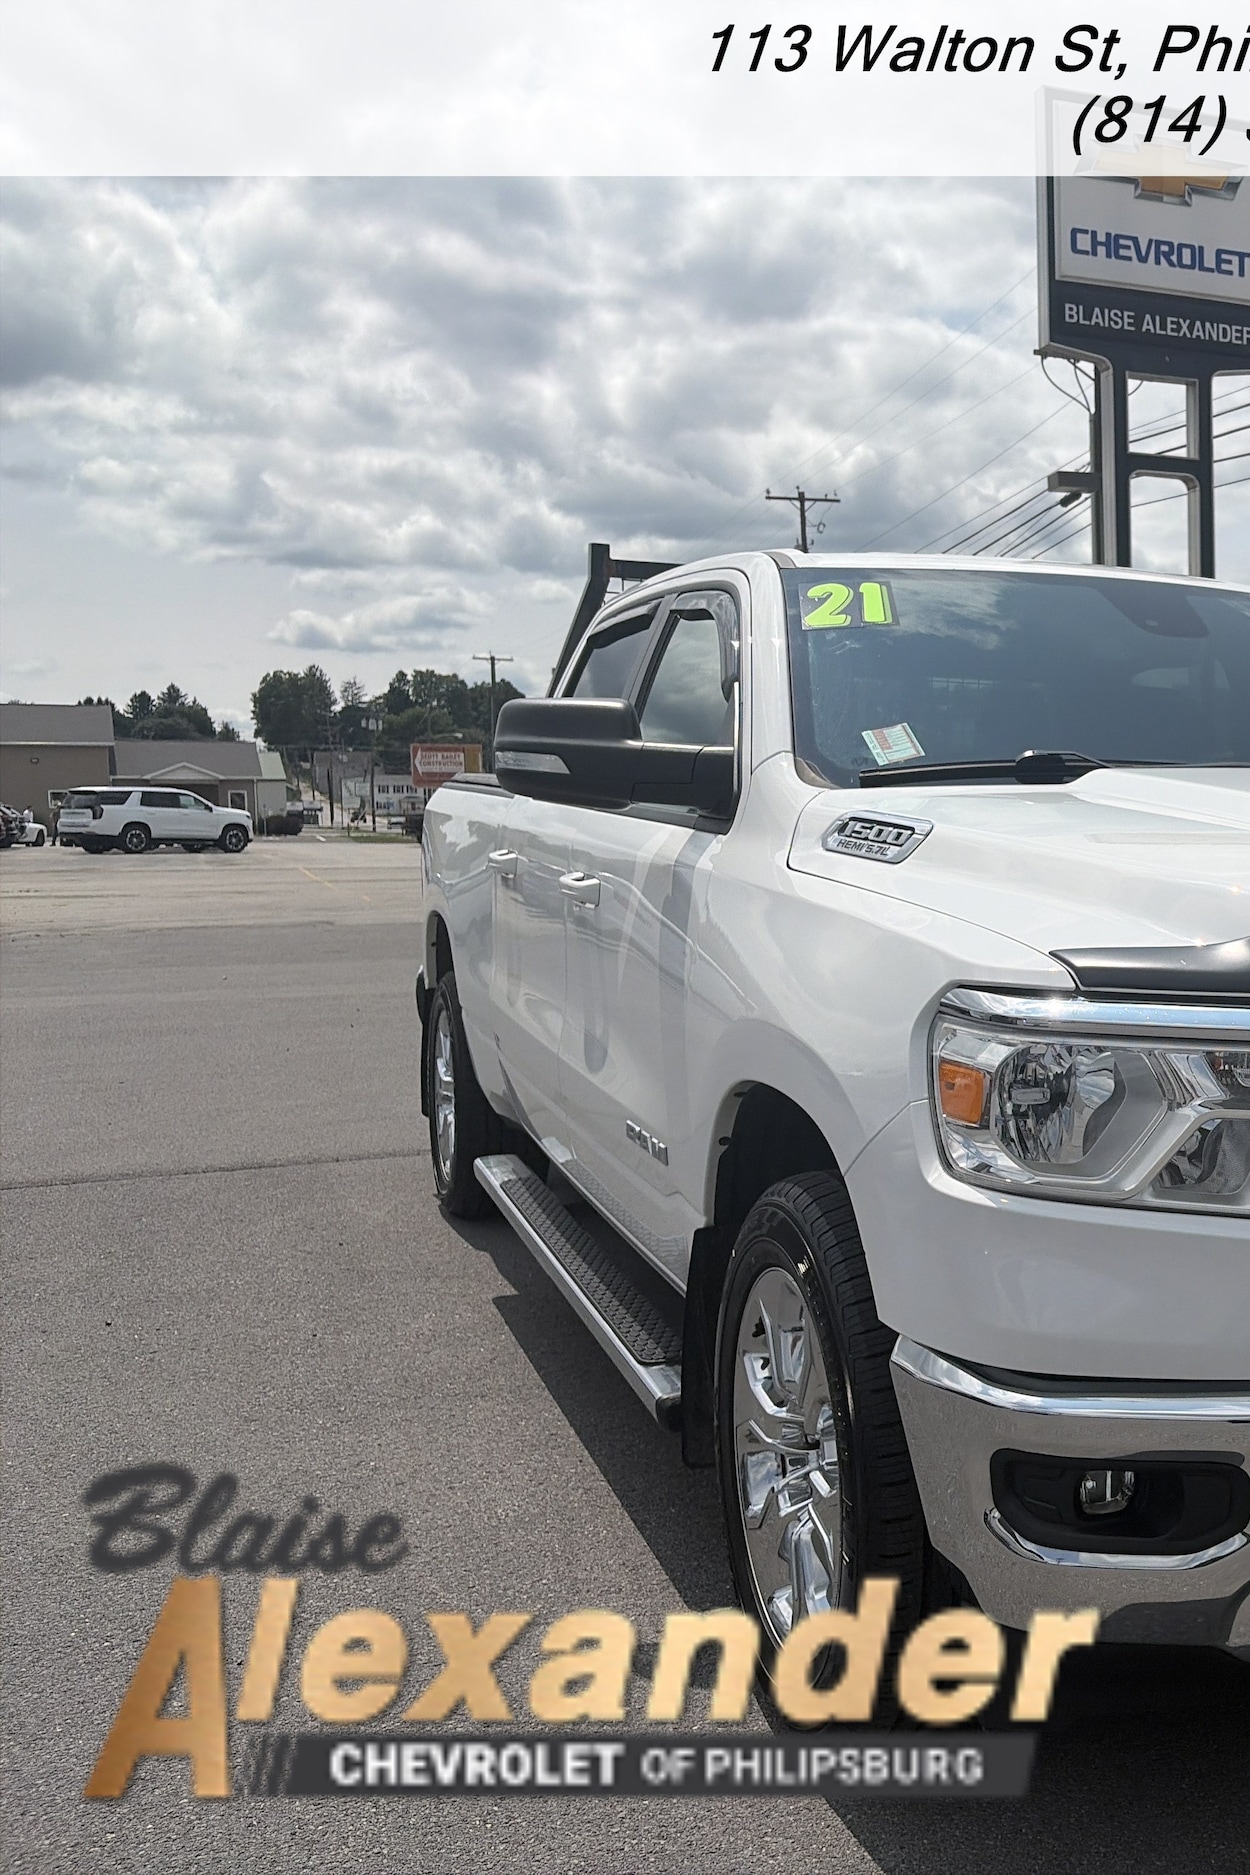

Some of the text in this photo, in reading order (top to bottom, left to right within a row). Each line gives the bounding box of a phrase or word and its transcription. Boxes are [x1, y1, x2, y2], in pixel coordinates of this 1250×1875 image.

[1070, 226, 1250, 278] CHEVROLET
[1064, 303, 1136, 332] BLAISE
[803, 582, 893, 628] 21
[419, 759, 464, 768] CONSTRUCTION
[843, 820, 911, 845] 1500
